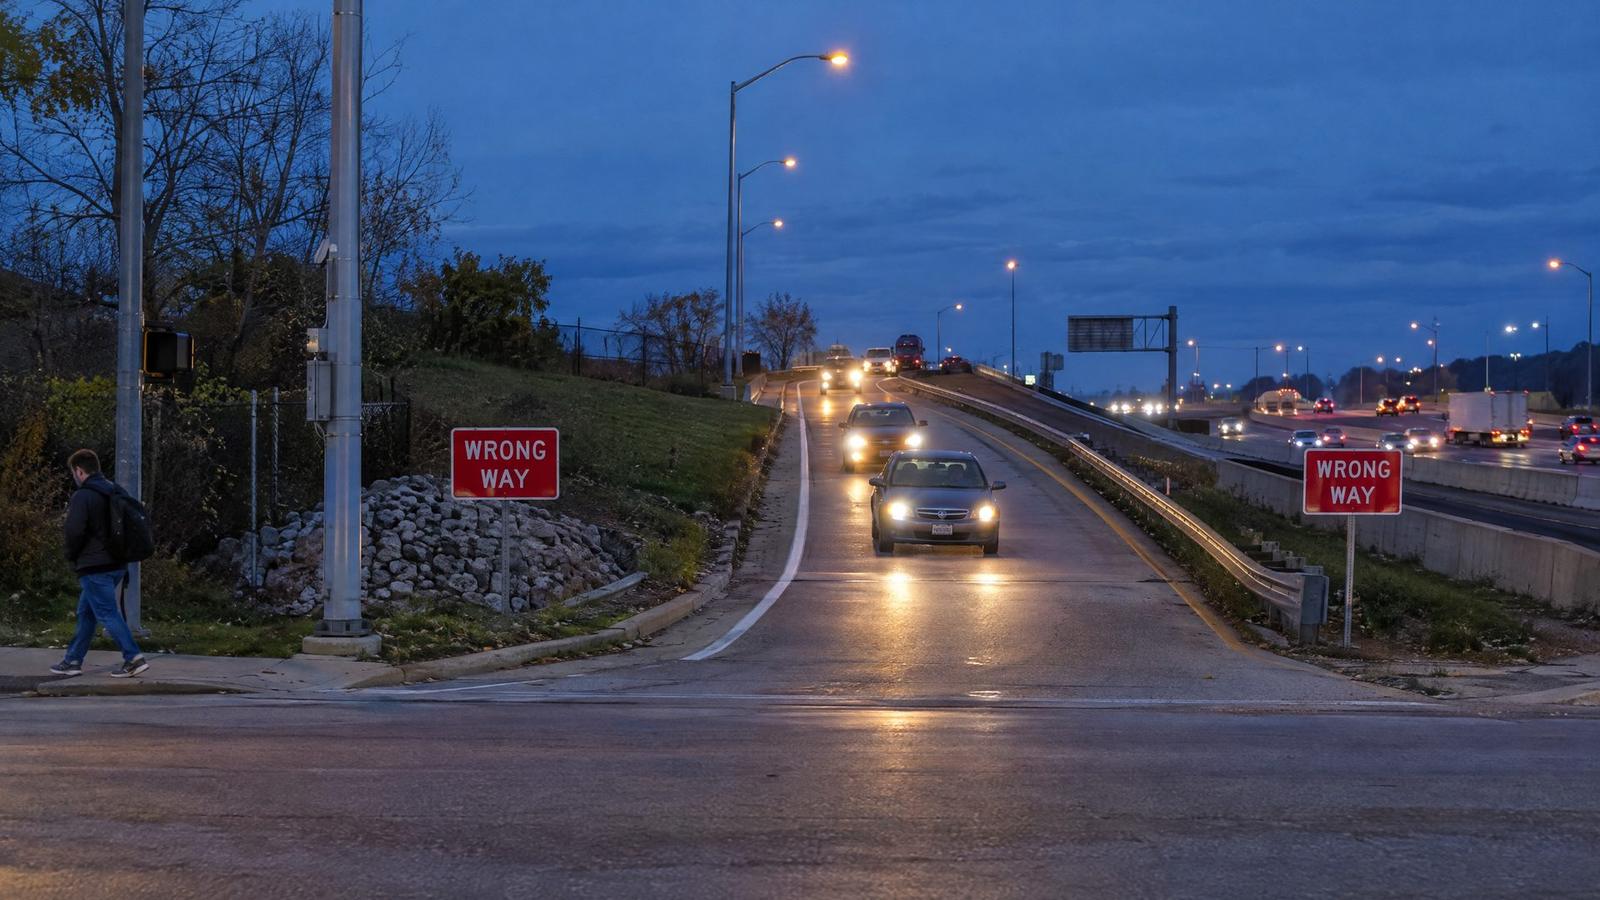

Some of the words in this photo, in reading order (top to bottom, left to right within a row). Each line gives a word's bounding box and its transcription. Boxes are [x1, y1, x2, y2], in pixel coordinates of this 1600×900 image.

[464, 440, 546, 460] WRONG
[481, 469, 530, 489] WAY
[1317, 460, 1391, 479] WRONG
[1330, 486, 1376, 505] WAY
